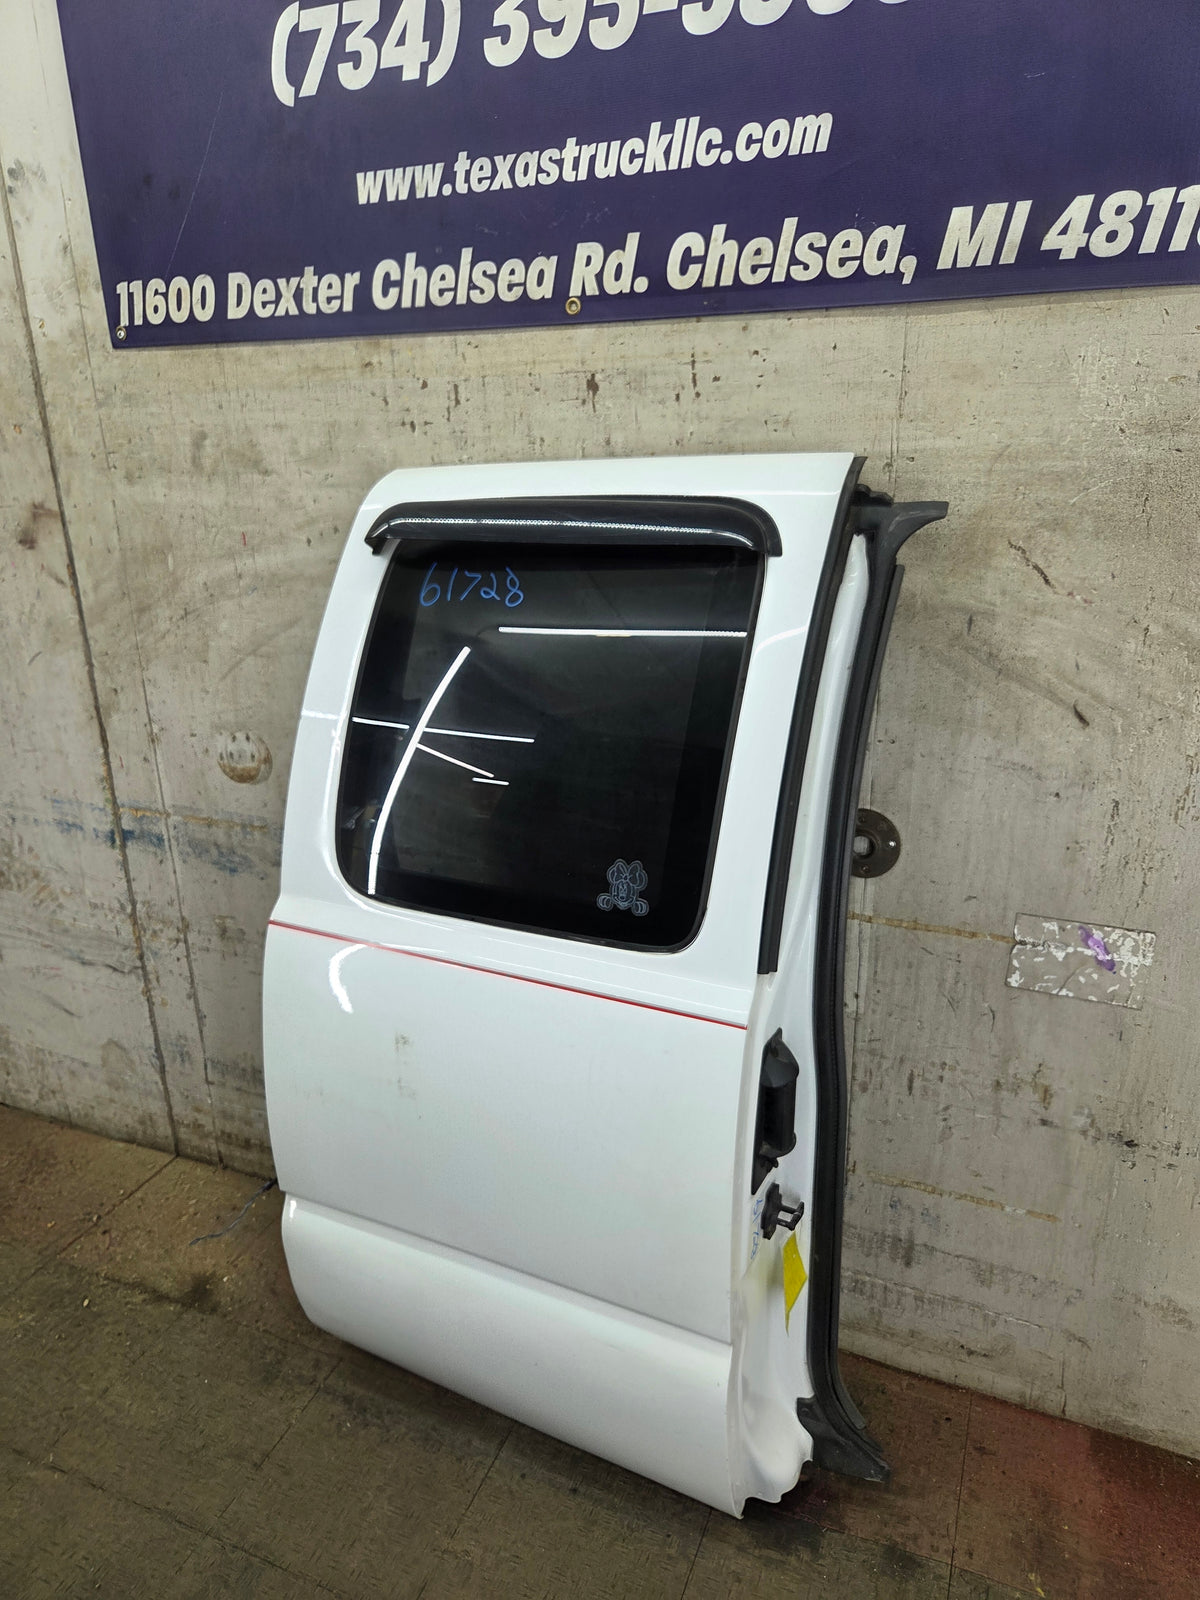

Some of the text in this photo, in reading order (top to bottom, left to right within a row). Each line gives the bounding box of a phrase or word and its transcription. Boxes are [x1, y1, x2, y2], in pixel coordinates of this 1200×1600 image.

[271, 0, 462, 107] (734)
[356, 112, 833, 205] www.texastruckllc.com
[116, 184, 1200, 328] 11600 Dexter Chelsea Rd. Chelsea, MI 4811
[419, 561, 525, 608] 61728
